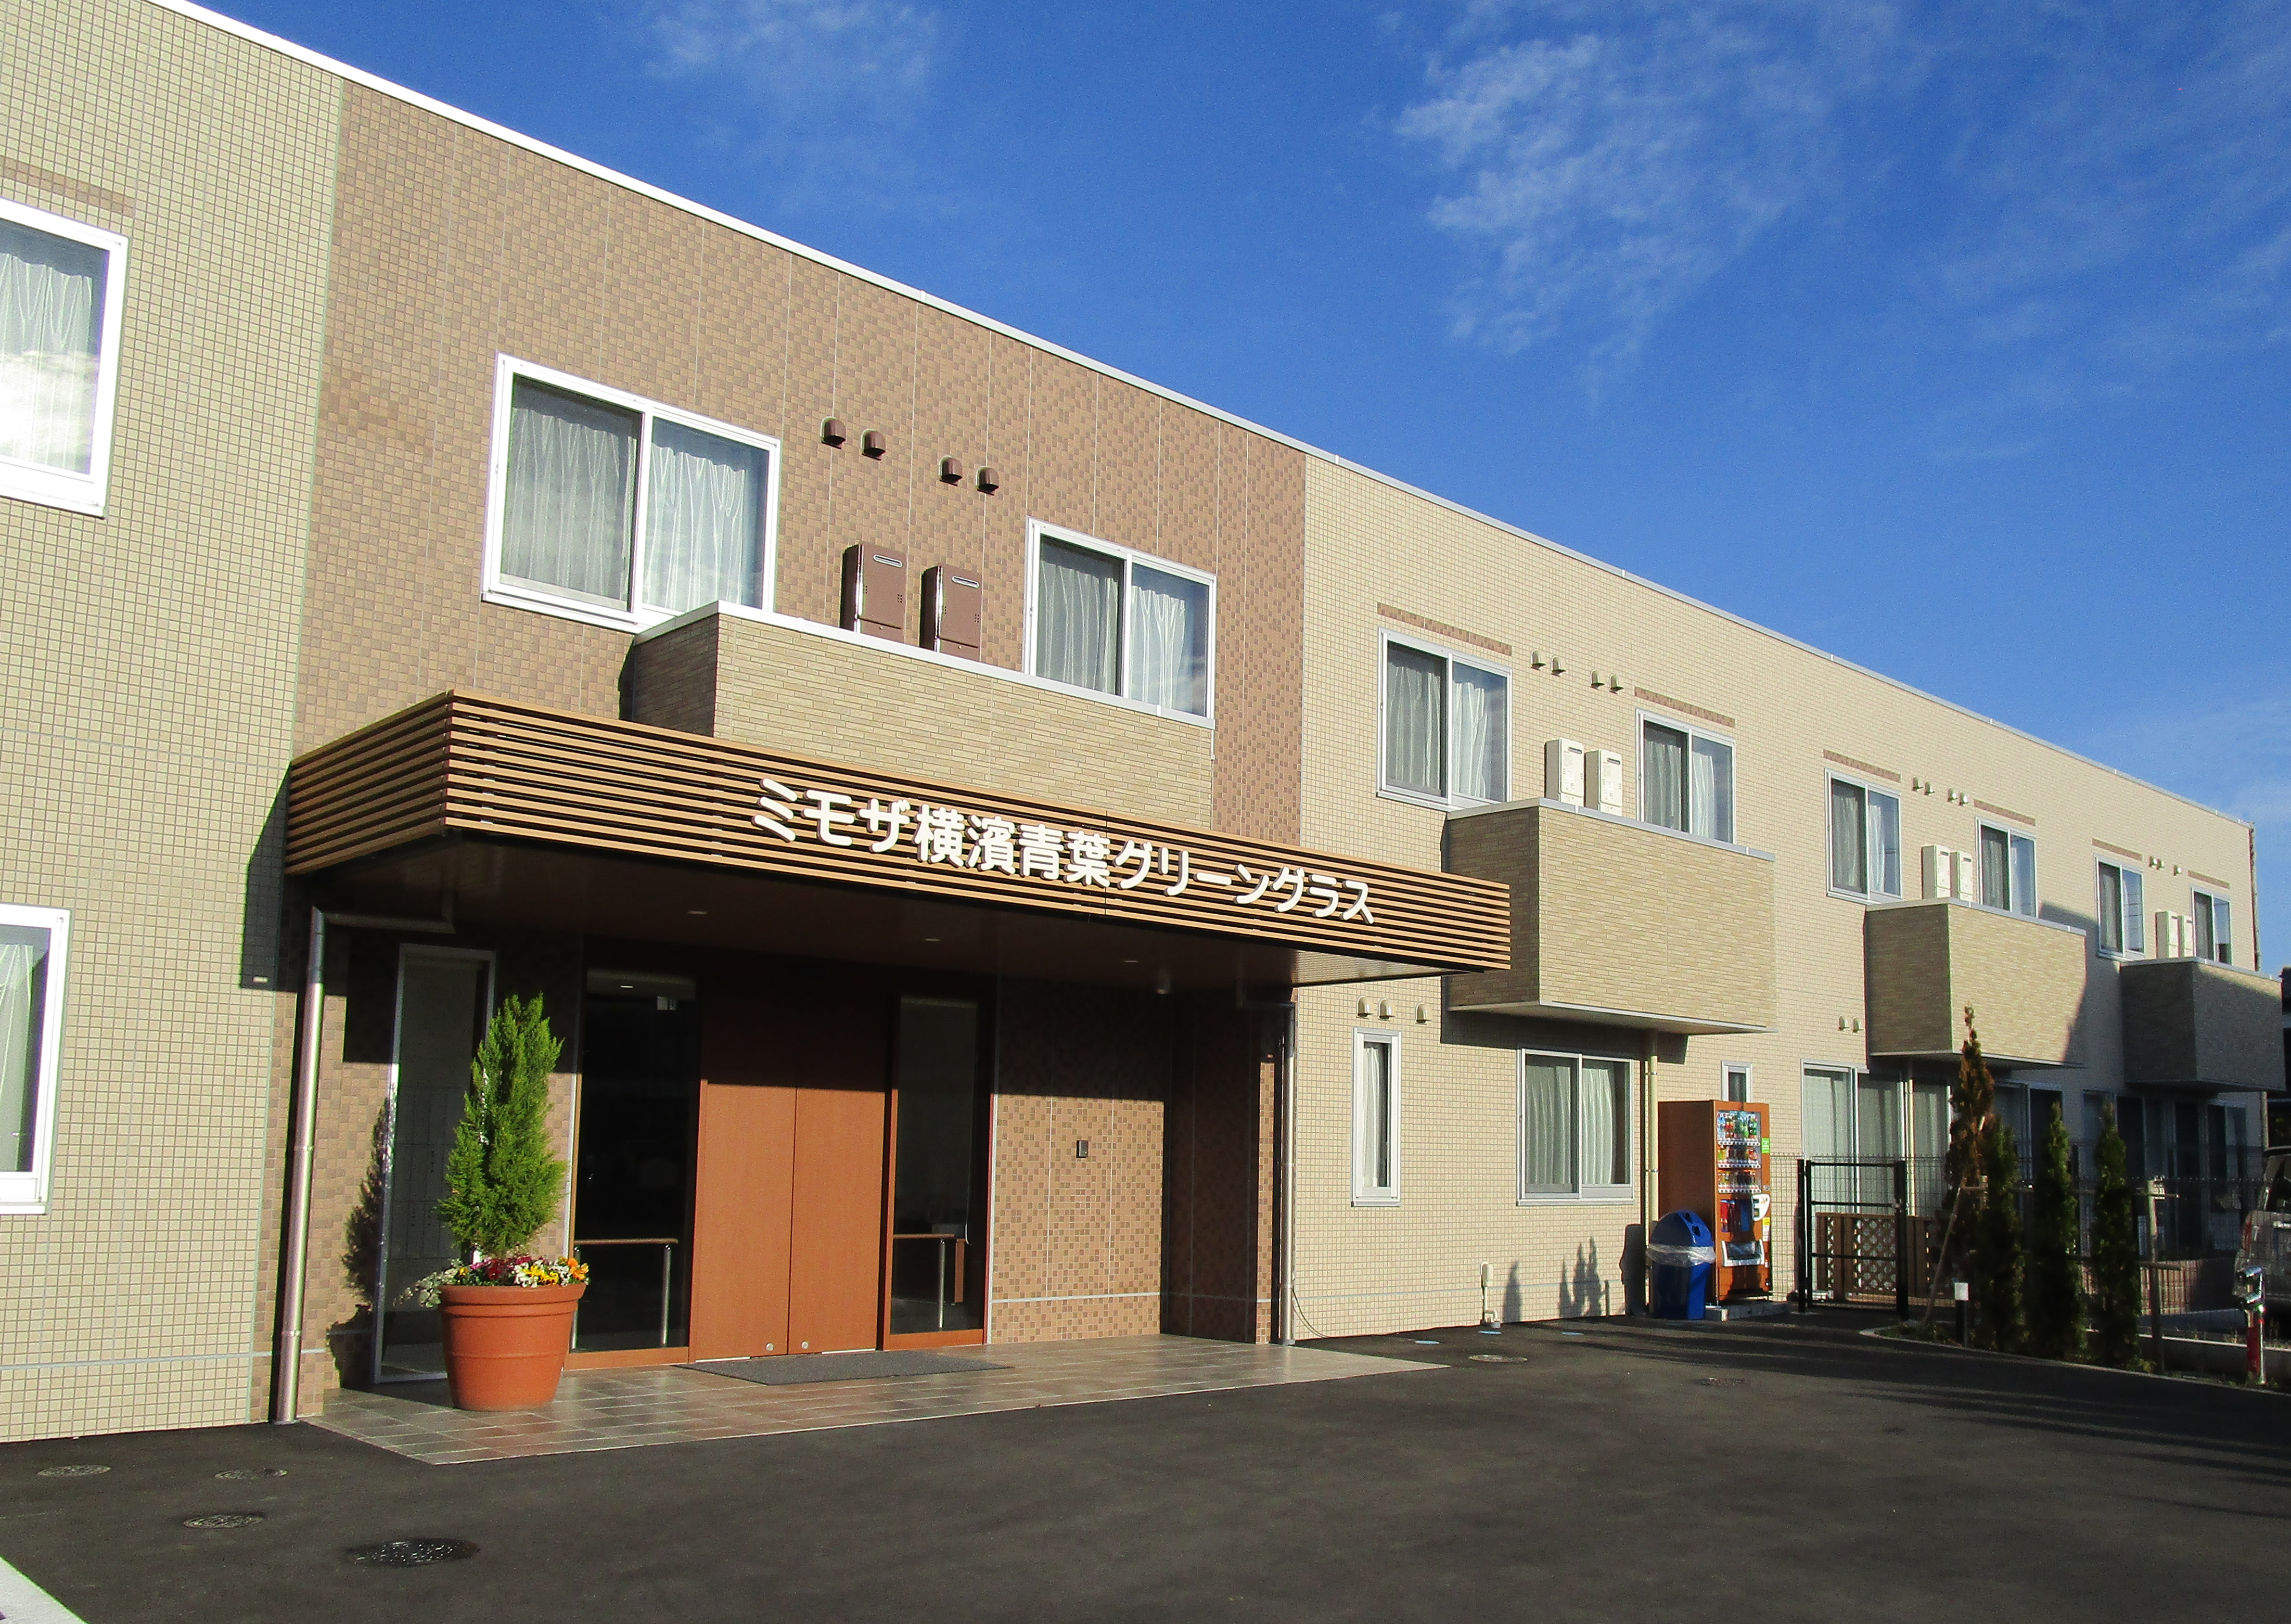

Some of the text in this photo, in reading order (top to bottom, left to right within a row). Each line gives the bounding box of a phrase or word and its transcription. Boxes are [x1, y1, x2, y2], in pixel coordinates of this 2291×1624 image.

[751, 778, 1374, 924] ミモザ横濱青葉グリーングラス
